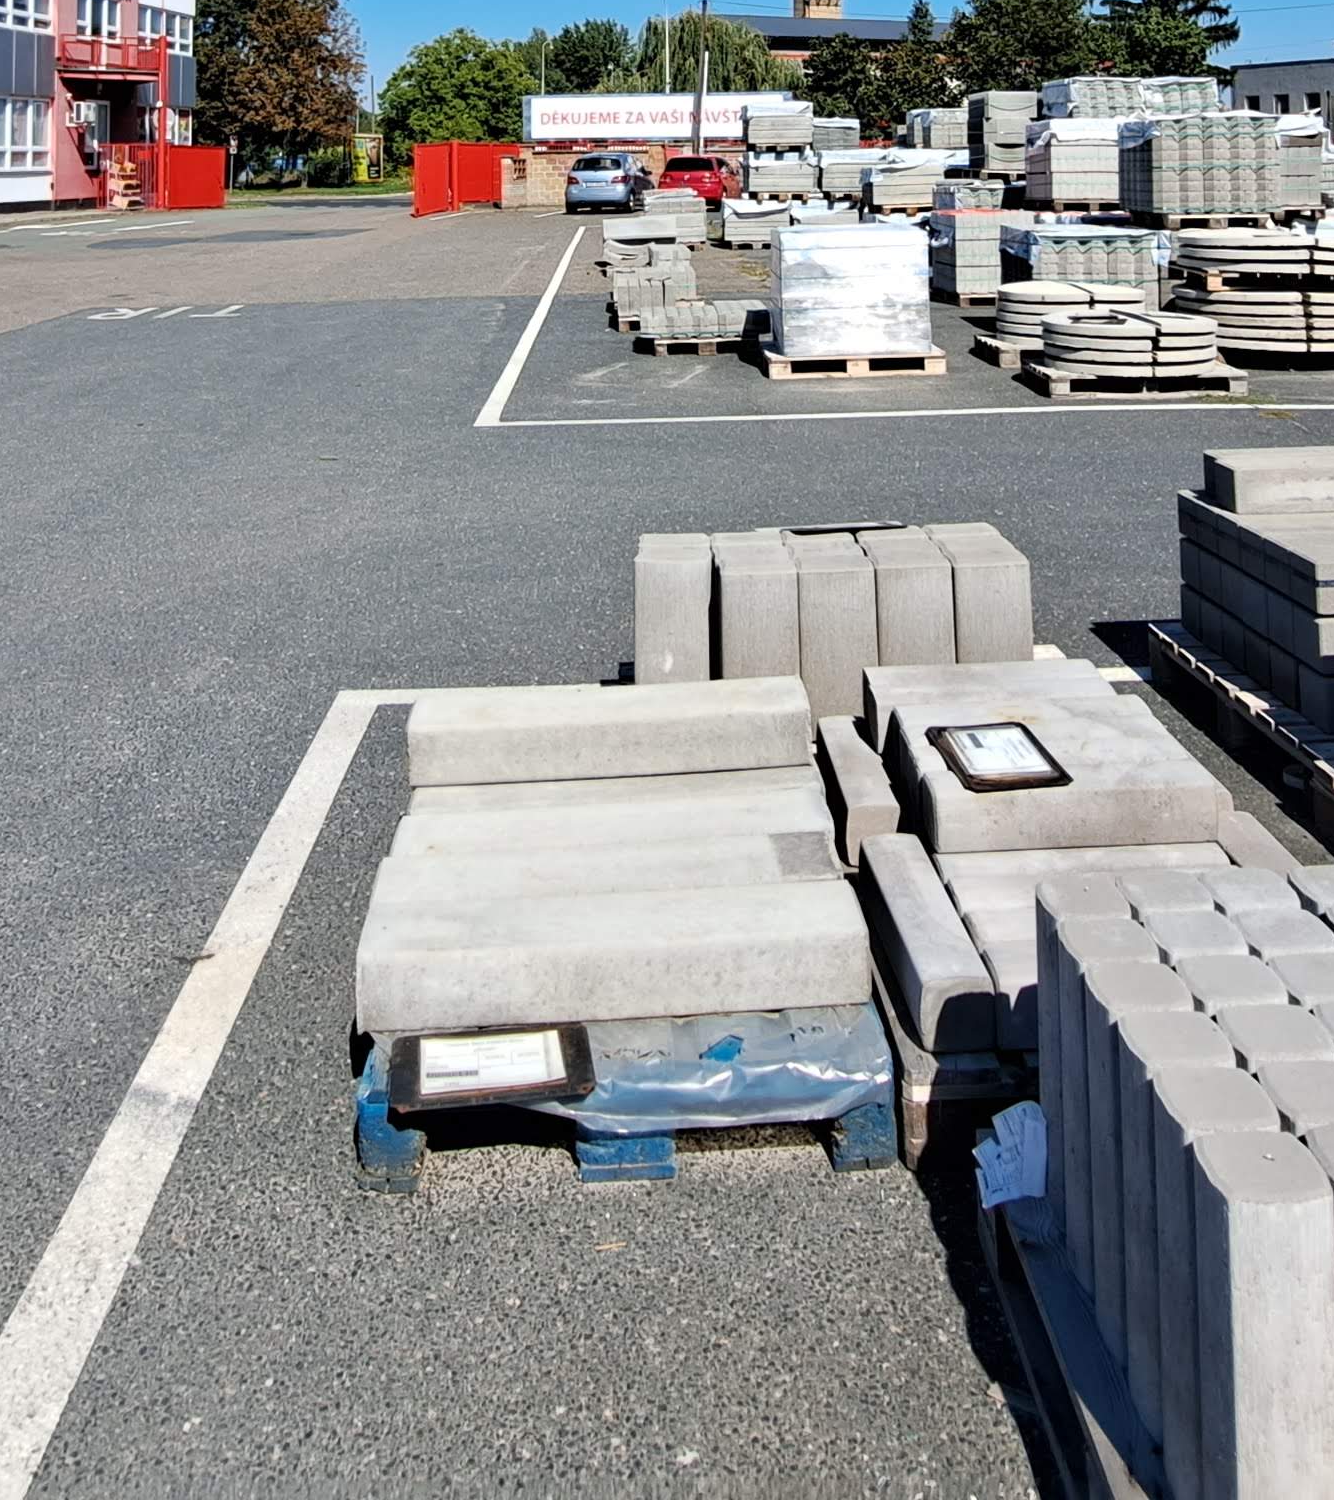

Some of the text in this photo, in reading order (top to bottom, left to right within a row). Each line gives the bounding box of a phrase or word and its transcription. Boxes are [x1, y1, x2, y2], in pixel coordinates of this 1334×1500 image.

[540, 107, 741, 126] DĚKUJEME ZA VAŠI NÁVŠT
